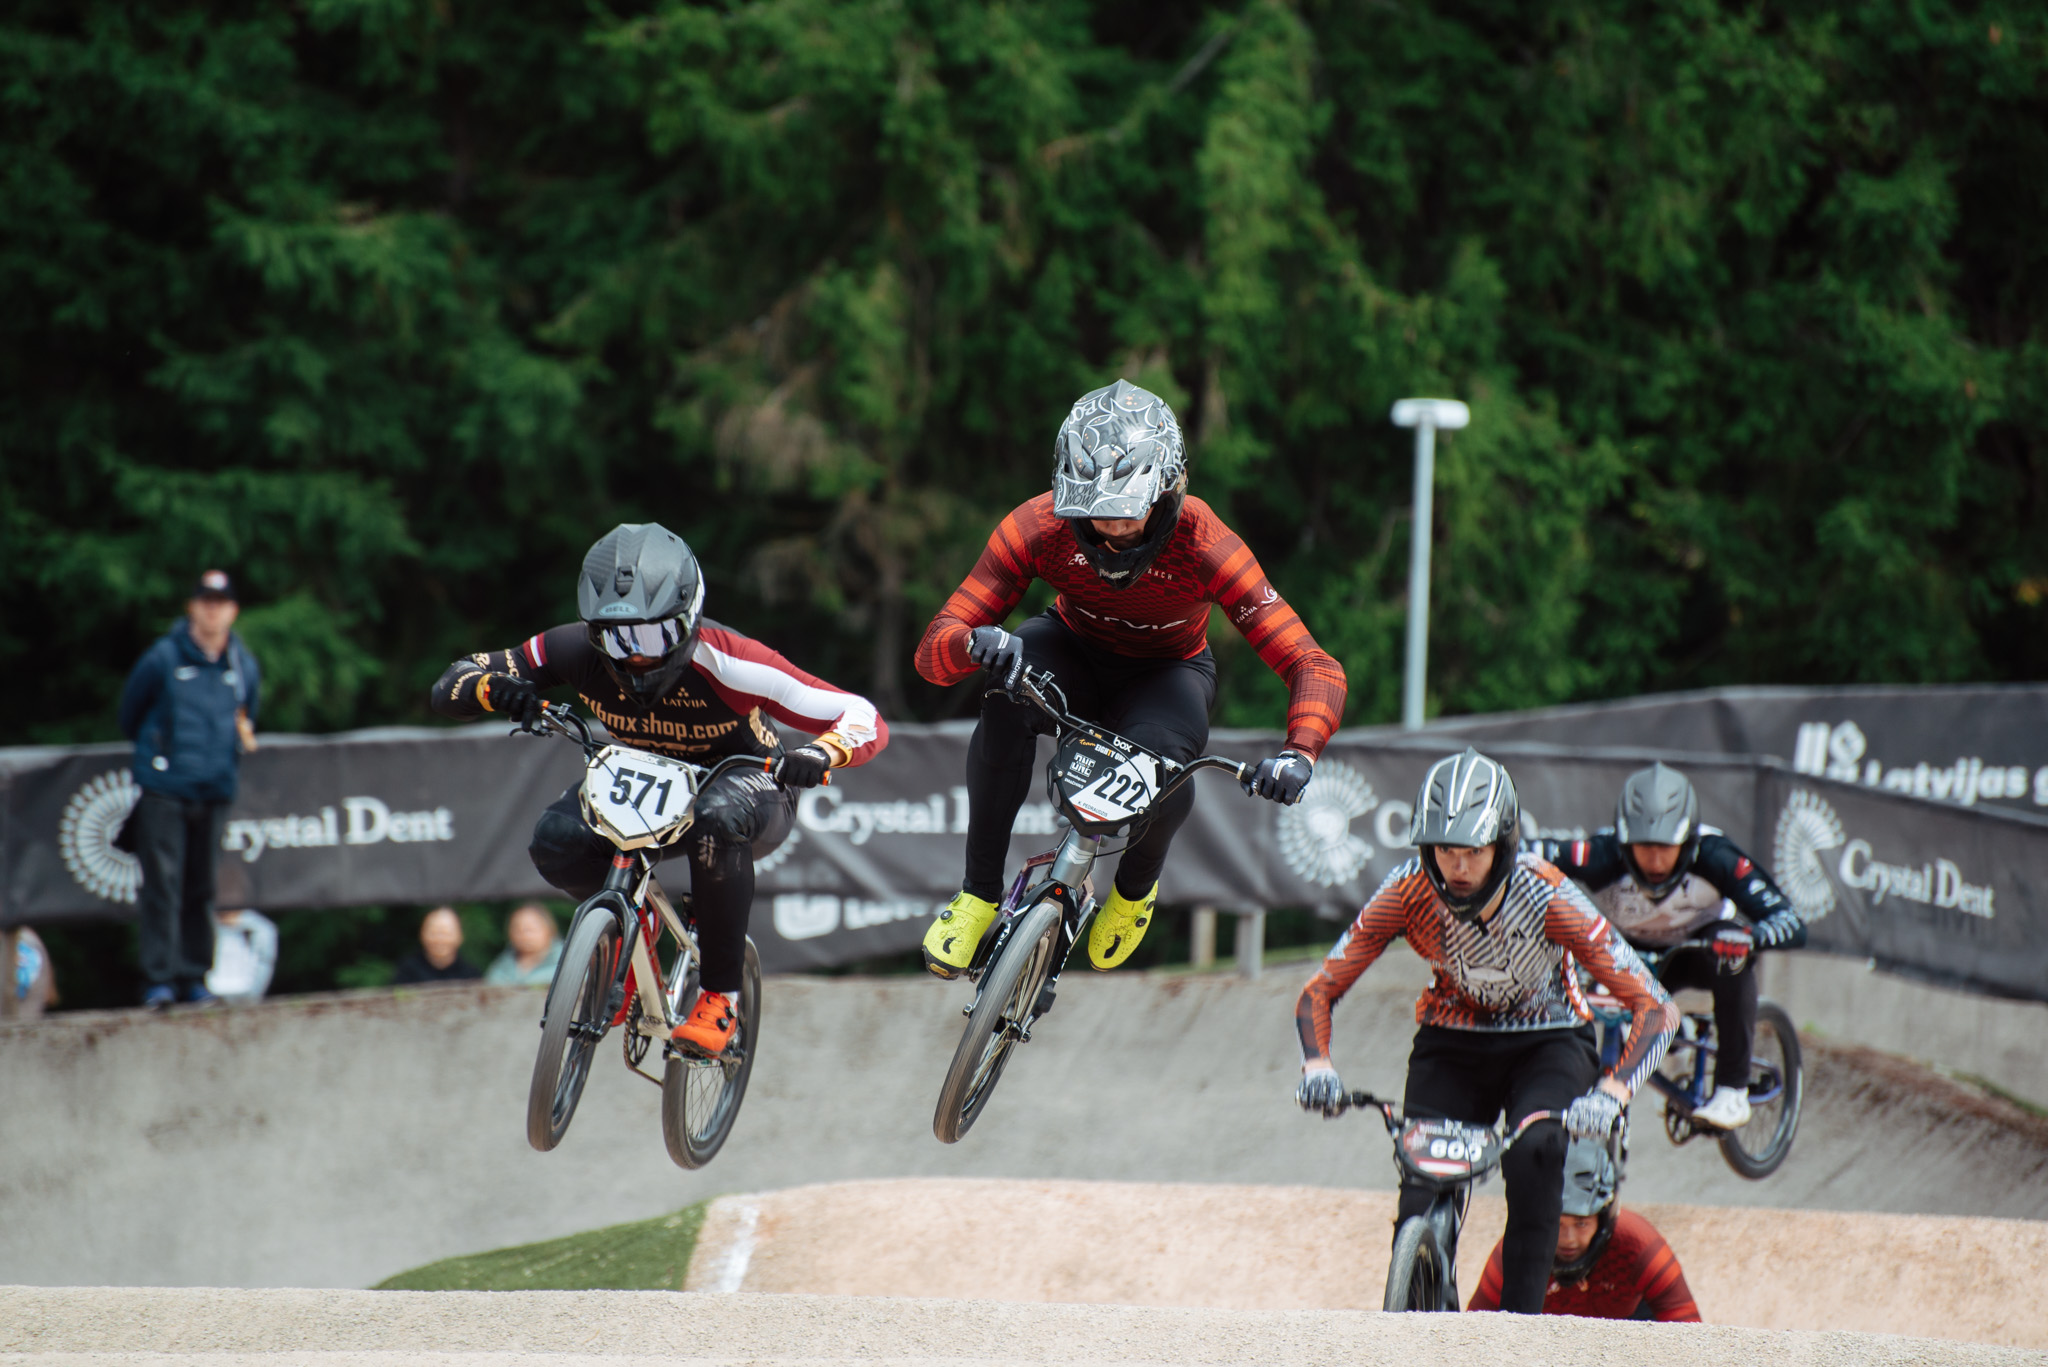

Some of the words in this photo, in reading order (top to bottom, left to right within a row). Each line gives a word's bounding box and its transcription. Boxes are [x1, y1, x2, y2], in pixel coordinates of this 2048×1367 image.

[1112, 736, 1134, 753] box
[608, 766, 673, 817] 571
[799, 785, 947, 846] Crystal
[1093, 767, 1147, 814] 222
[221, 805, 339, 863] rystal
[342, 796, 454, 845] Dent
[1839, 838, 1933, 906] Crystal
[1934, 857, 1996, 920] Dent
